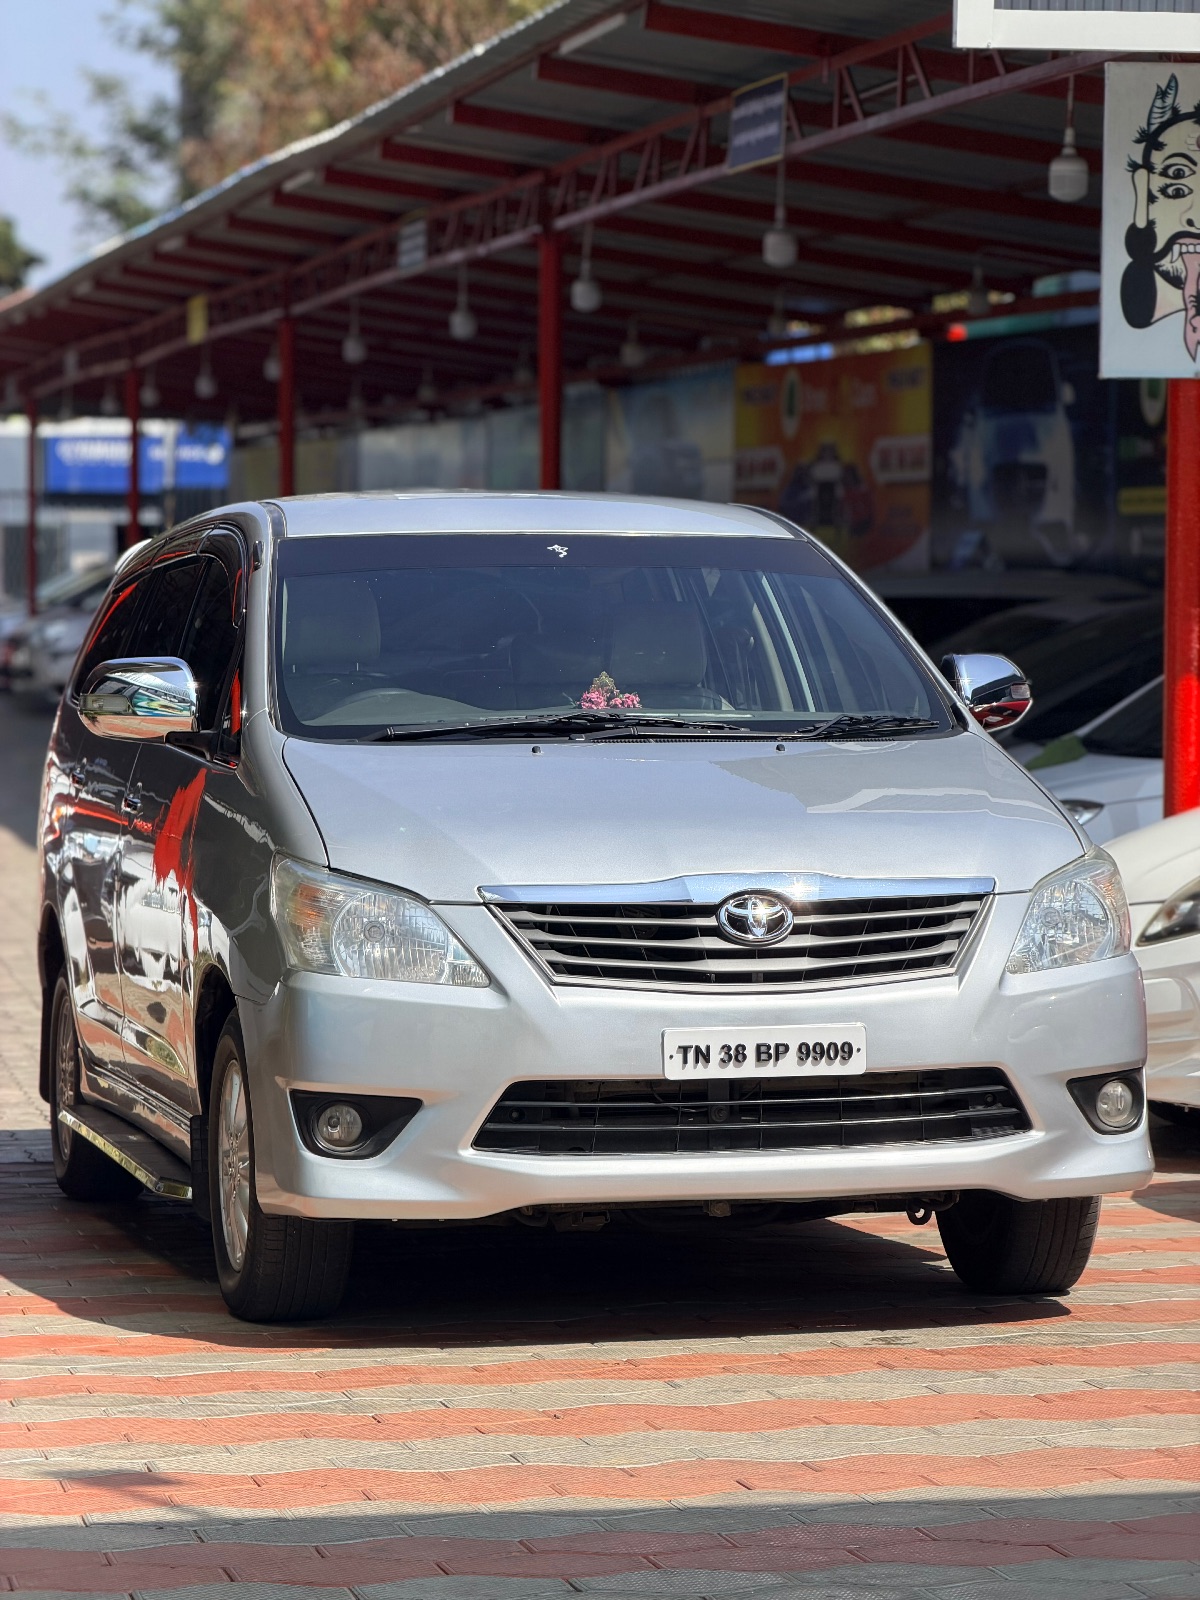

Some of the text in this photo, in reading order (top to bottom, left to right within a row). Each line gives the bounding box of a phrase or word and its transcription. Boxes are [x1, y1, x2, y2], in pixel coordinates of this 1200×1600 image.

[677, 1041, 854, 1065] TN 38 BP 9909
